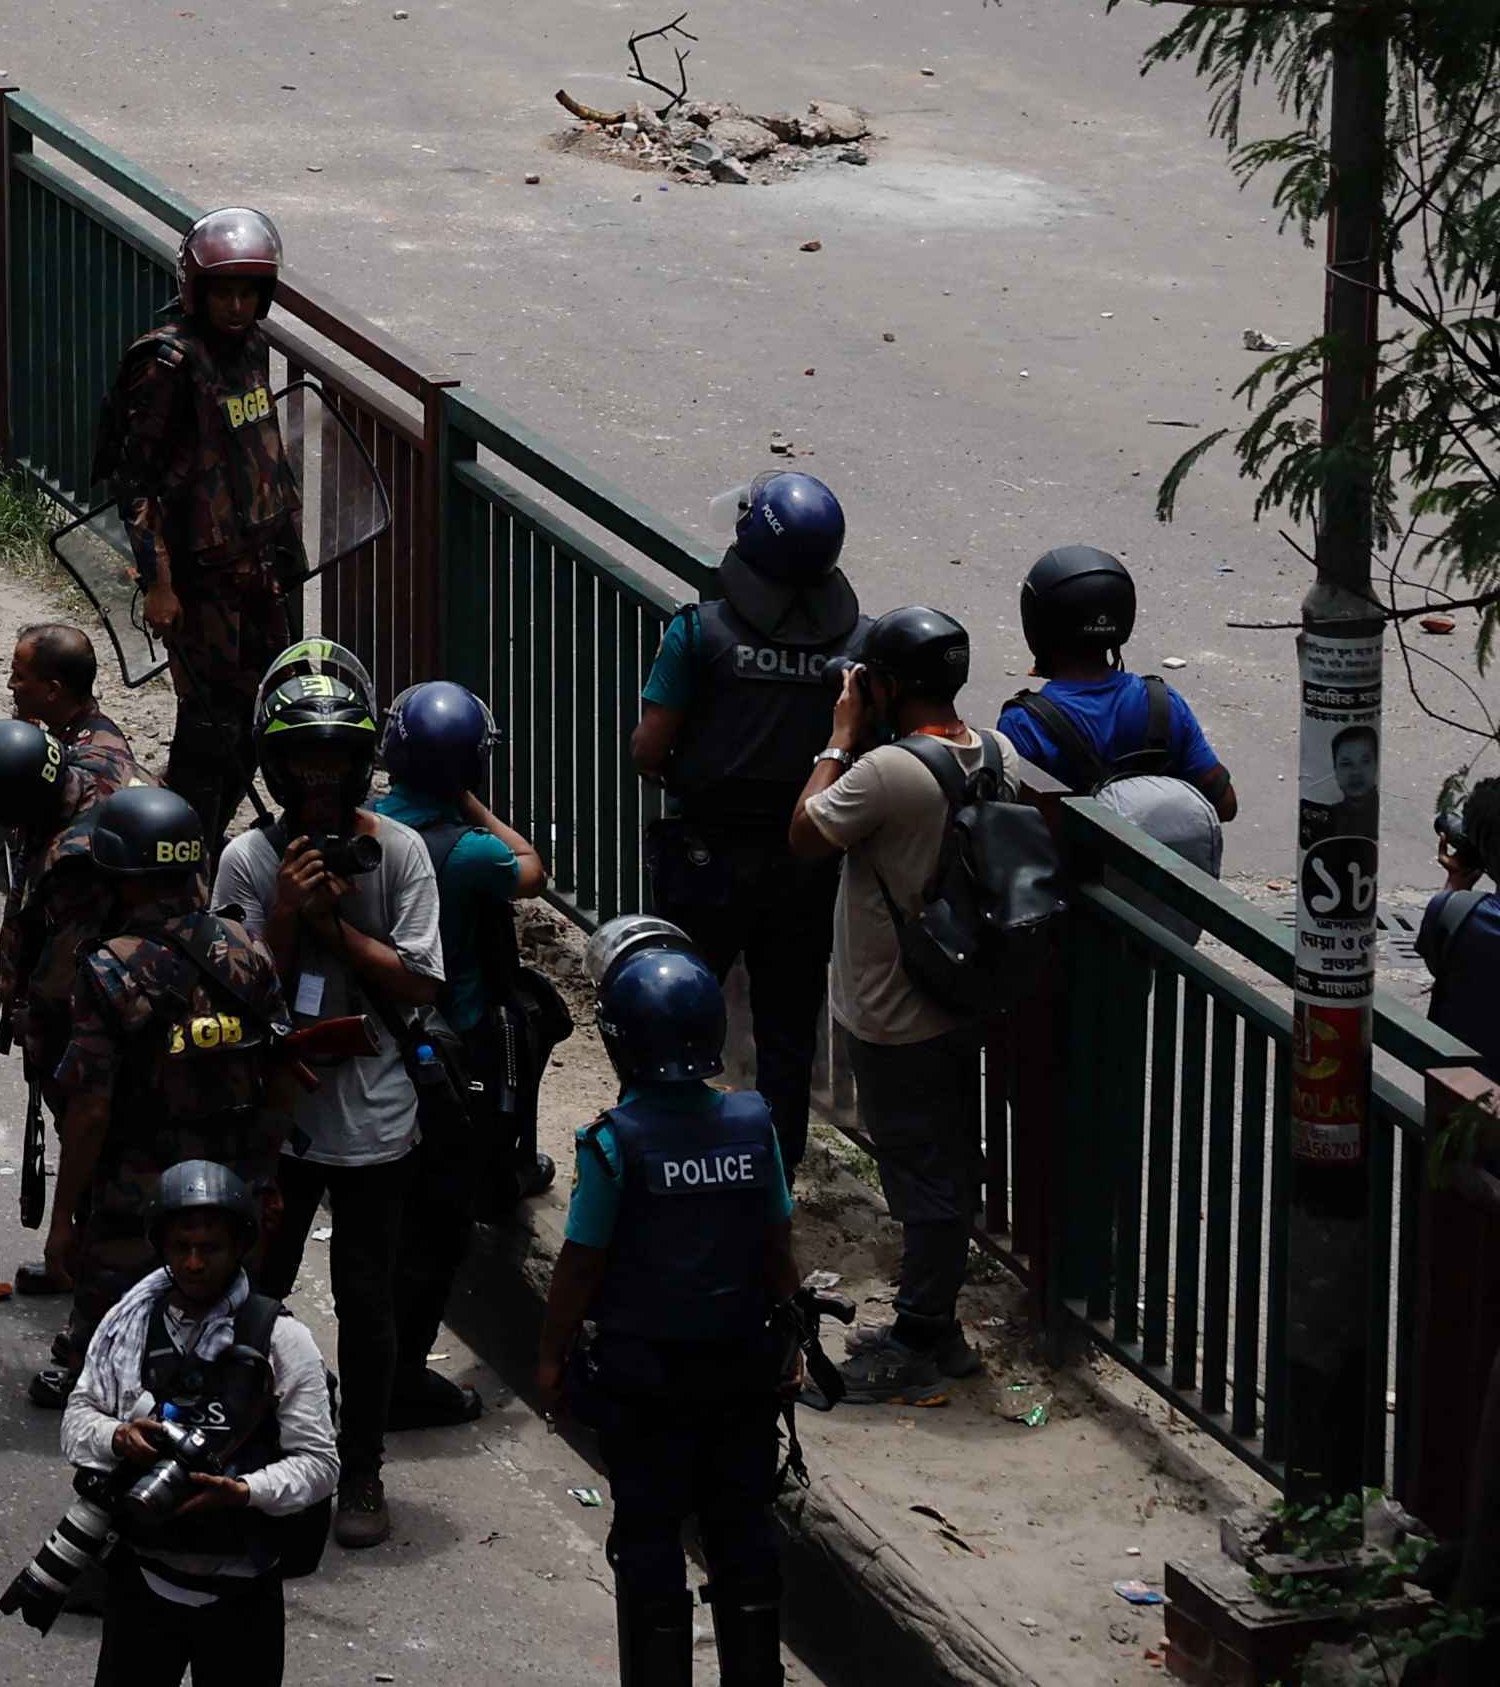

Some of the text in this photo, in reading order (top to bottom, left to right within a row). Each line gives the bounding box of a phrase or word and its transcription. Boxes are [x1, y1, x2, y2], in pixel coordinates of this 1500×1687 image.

[227, 387, 270, 428] BGB
[735, 644, 834, 677] POLIC
[156, 841, 201, 863] BGB
[1297, 1093, 1358, 1119] OLAR
[662, 1150, 756, 1190] POLICE
